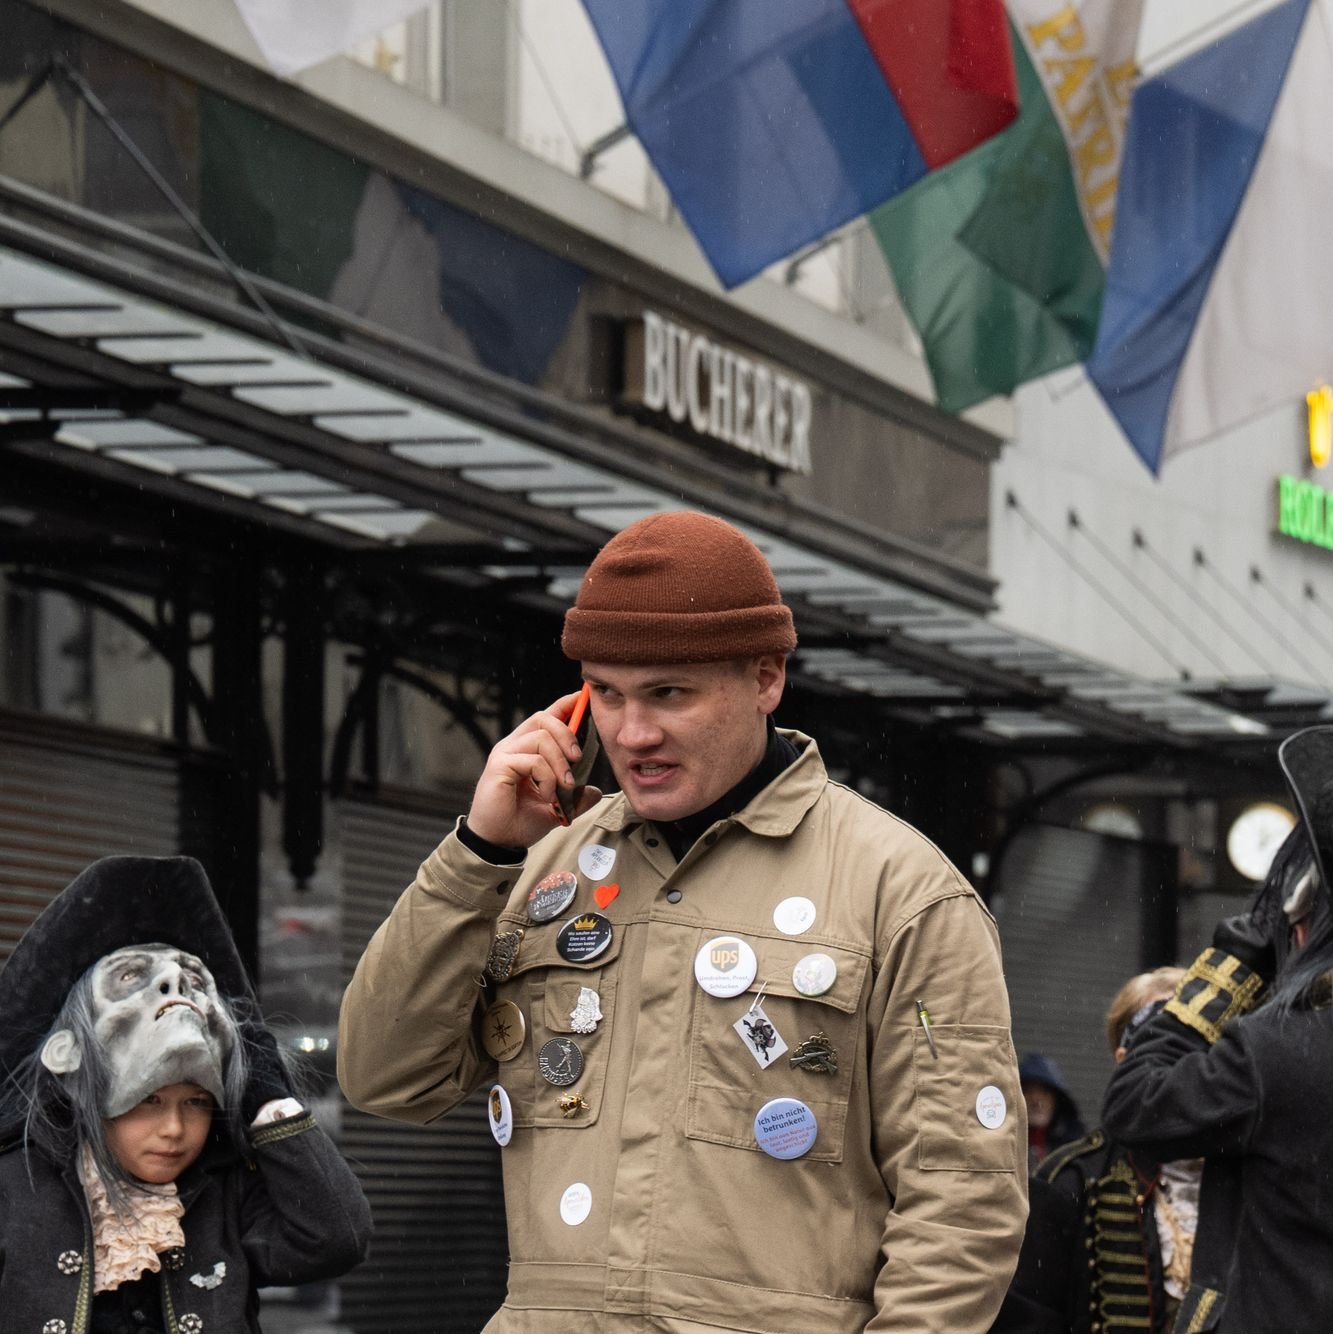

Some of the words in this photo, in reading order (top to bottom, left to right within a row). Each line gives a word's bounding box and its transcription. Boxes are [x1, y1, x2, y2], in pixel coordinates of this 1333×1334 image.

[643, 309, 813, 476] BUCHERER
[712, 950, 738, 969] ups
[757, 1117, 770, 1126] Ich
[771, 1113, 784, 1122] bin
[785, 1106, 806, 1118] nicht
[763, 1115, 806, 1133] betrunken!
